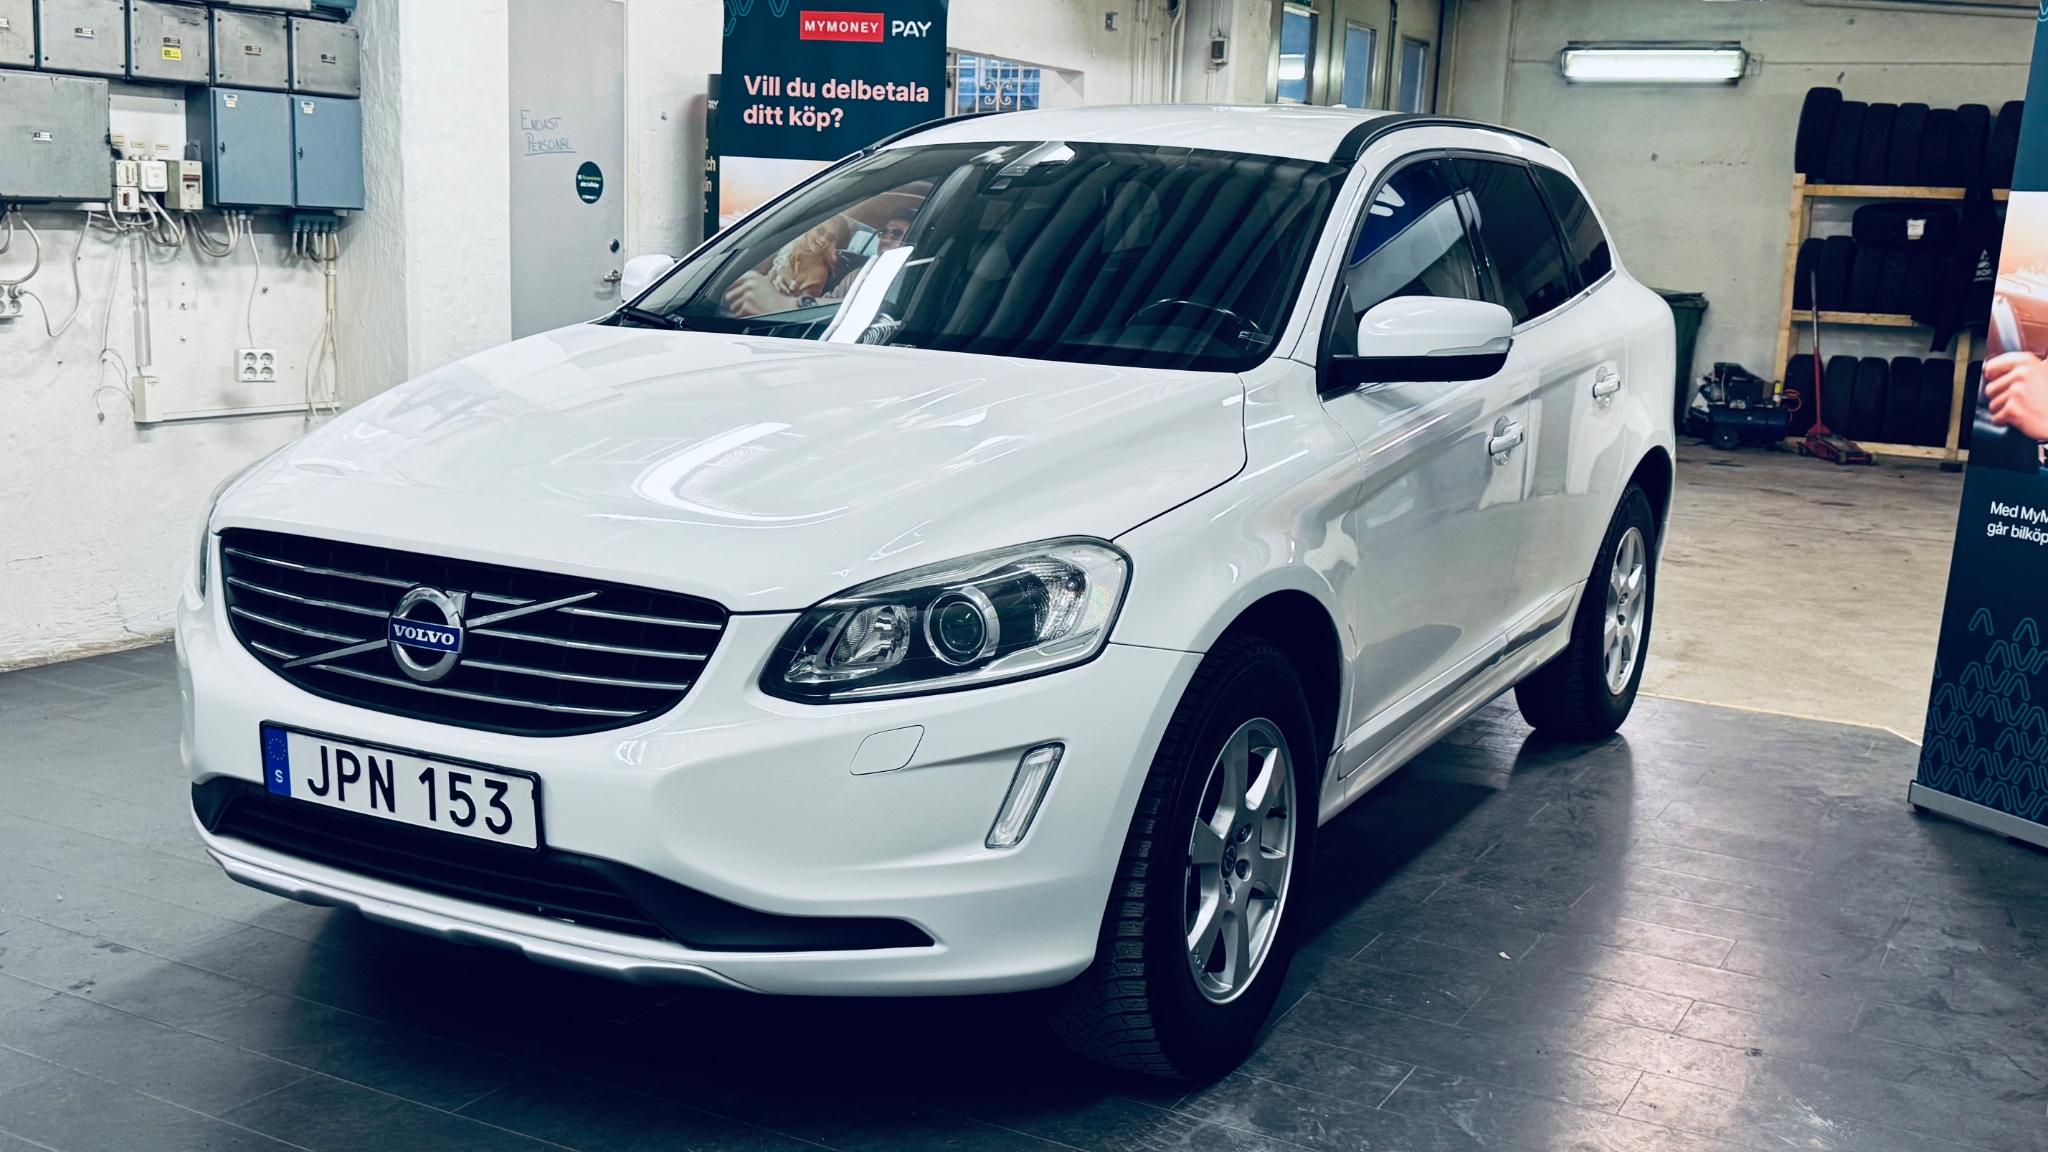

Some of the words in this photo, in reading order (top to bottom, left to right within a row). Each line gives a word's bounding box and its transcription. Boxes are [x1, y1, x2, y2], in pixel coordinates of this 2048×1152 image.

[804, 20, 879, 33] MYMONEY
[892, 20, 932, 37] PAY
[743, 75, 780, 96] Vill
[786, 77, 816, 98] du
[821, 79, 929, 102] delbetala
[743, 104, 783, 125] ditt
[789, 105, 844, 132] köp?
[1990, 501, 2019, 518] Med
[1986, 521, 2010, 537] går
[2010, 524, 2048, 546] bilköp
[393, 624, 455, 645] VOLVO
[275, 769, 284, 783] S
[307, 746, 396, 813] JPN
[418, 766, 513, 835] 153
